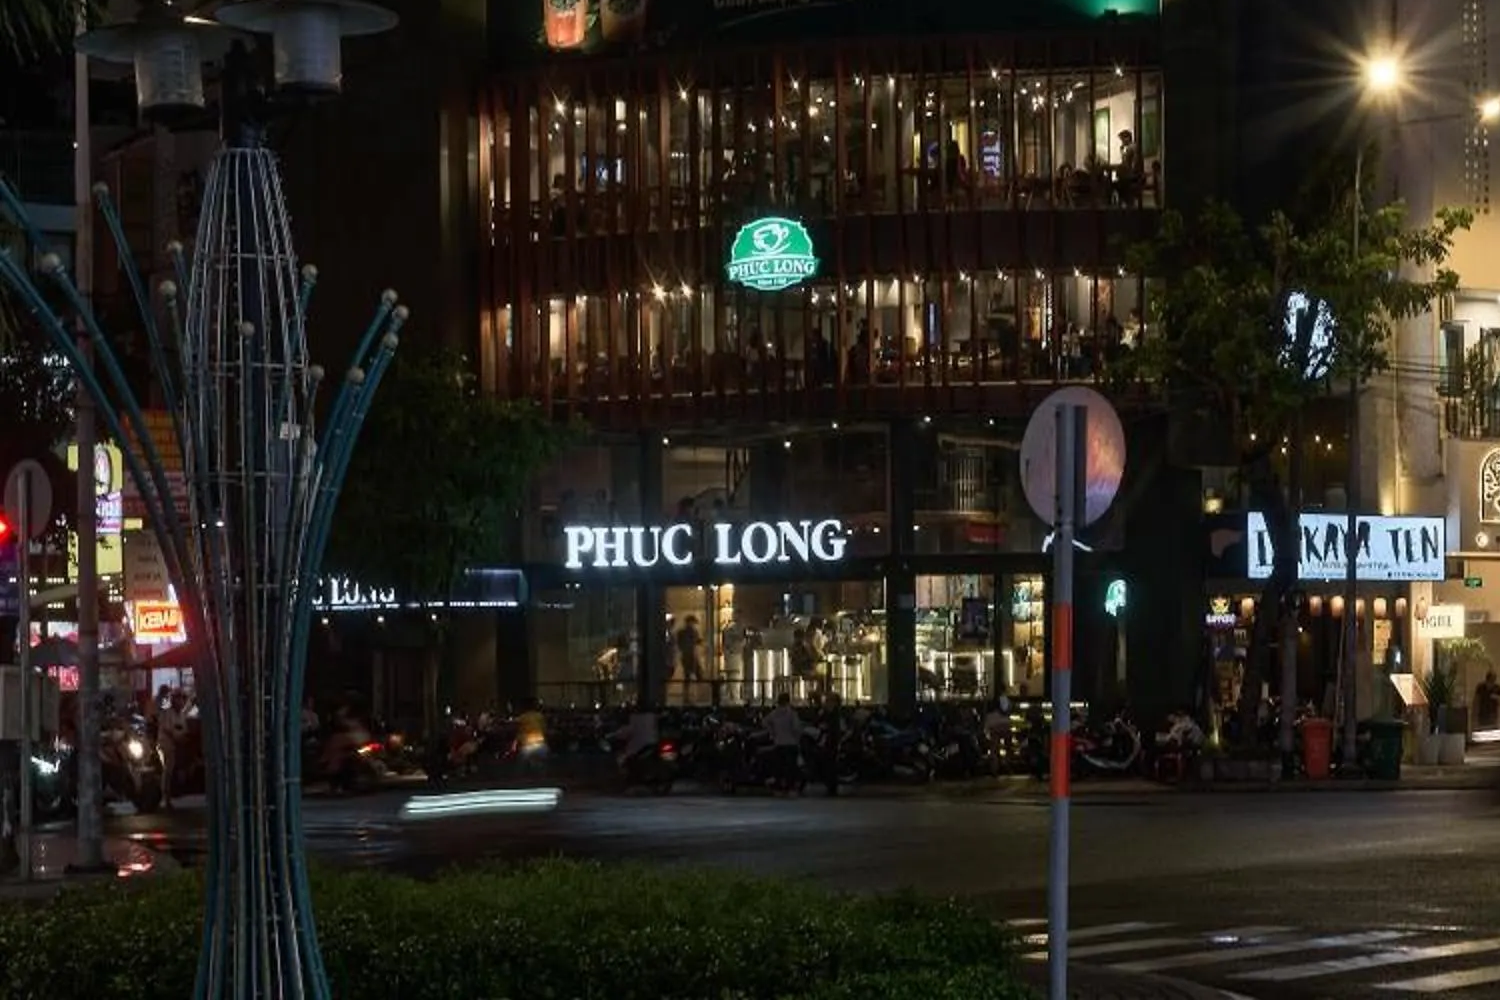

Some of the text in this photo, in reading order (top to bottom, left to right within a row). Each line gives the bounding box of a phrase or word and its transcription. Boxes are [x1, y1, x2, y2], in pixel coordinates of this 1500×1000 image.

[774, 259, 814, 275] LONG
[564, 518, 848, 569] PHUC LONG
[1386, 524, 1439, 565] TEN
